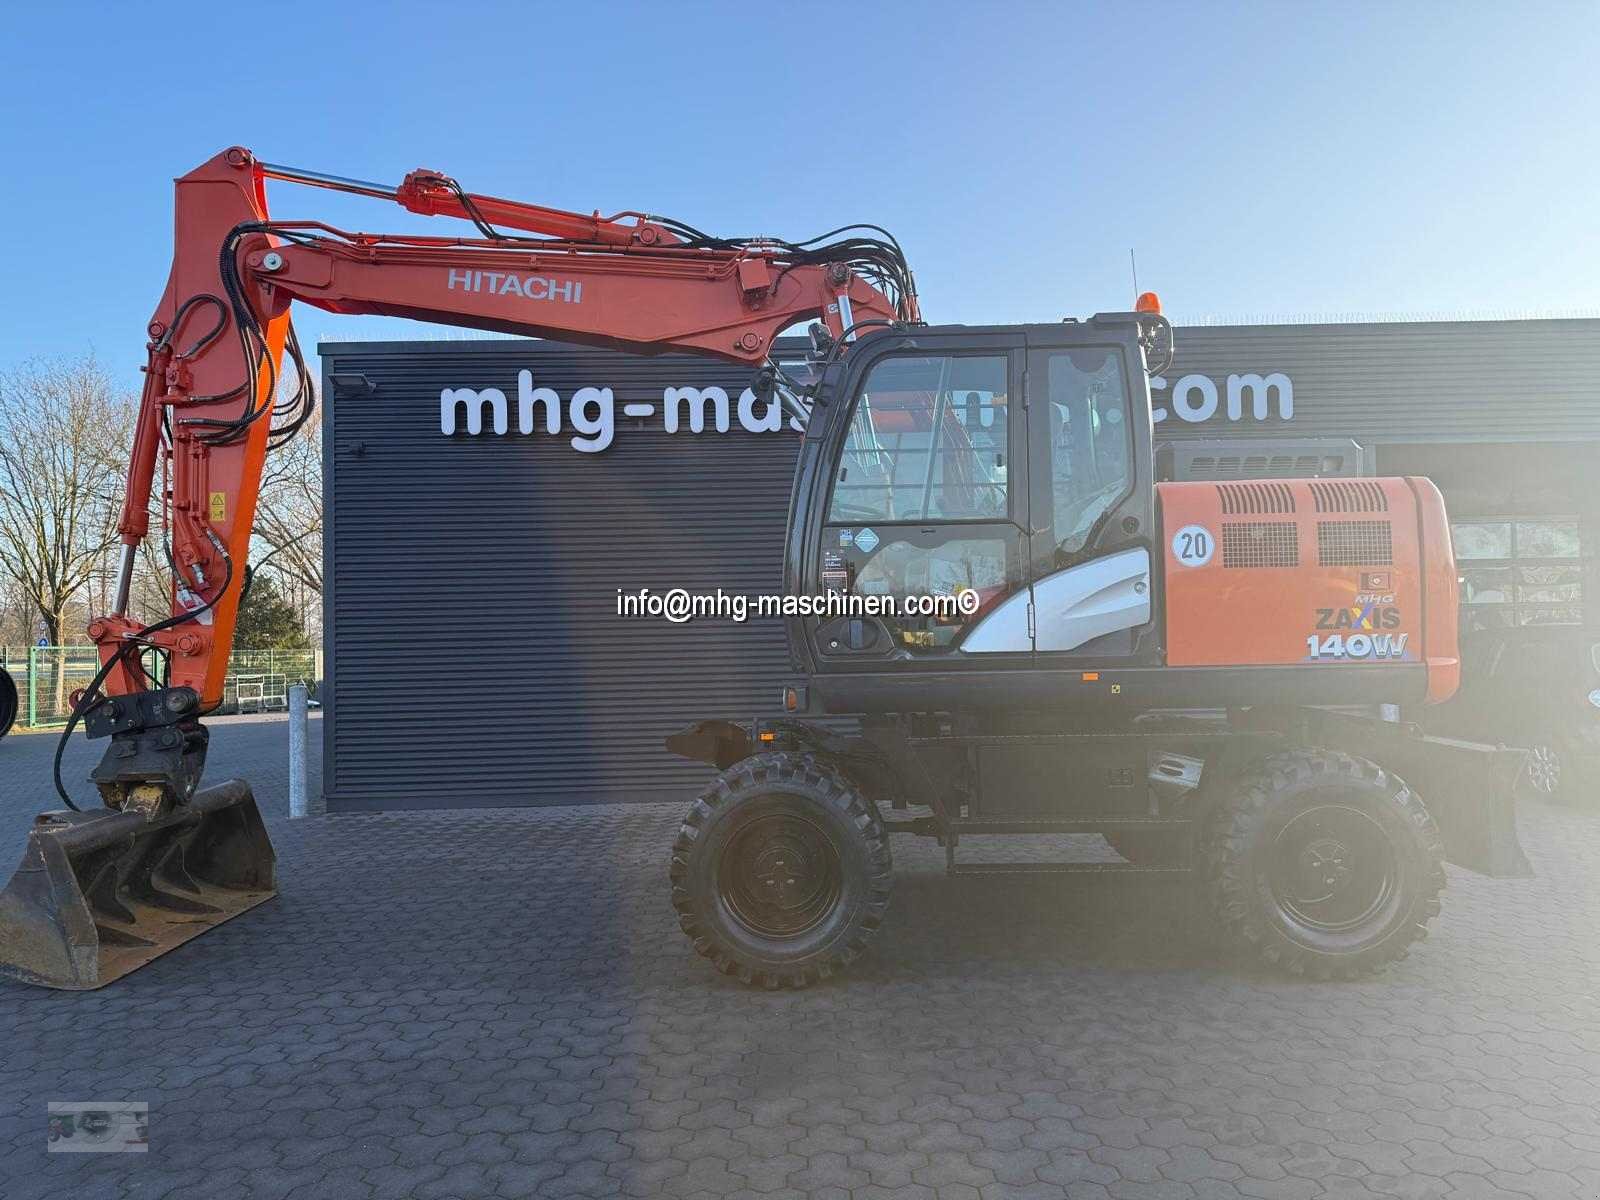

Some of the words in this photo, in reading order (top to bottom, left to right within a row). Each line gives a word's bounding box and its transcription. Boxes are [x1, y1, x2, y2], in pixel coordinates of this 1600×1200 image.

[448, 268, 582, 304] HITACHI
[440, 368, 806, 453] mhg-ma
[1181, 532, 1206, 559] 20
[1315, 602, 1400, 630] ZAXIS
[1307, 633, 1408, 659] 140W
